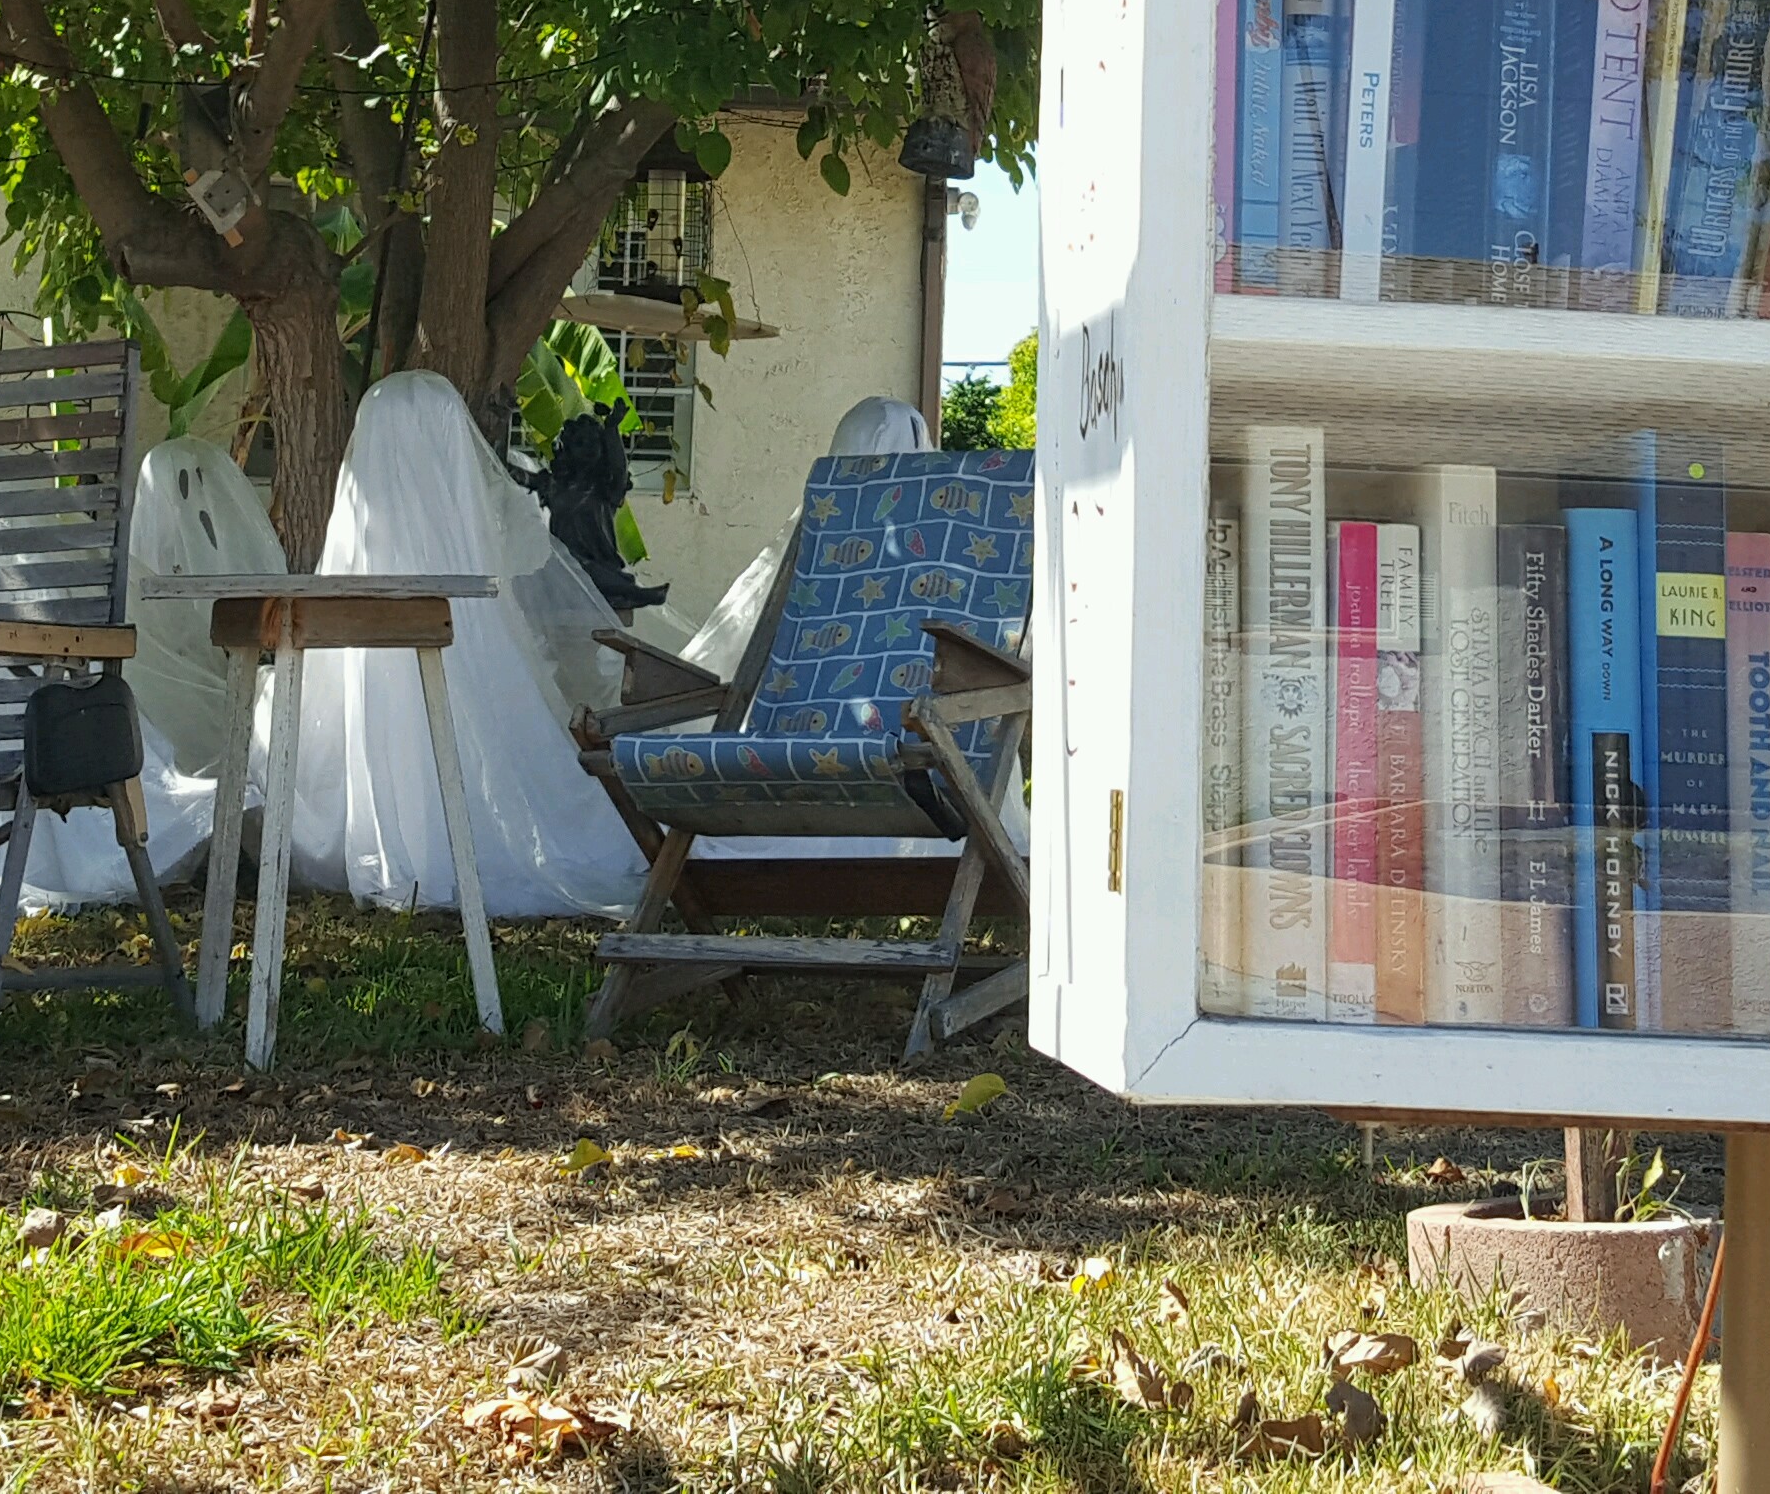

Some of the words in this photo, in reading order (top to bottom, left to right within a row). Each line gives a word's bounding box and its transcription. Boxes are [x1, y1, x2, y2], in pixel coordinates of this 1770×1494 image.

[1499, 43, 1526, 146] JACKSON
[1519, 61, 1538, 108] LISA
[1598, 27, 1642, 140] TENT
[1270, 443, 1312, 516] TONY
[1448, 501, 1490, 525] Fitch
[1521, 552, 1547, 601] Fifty
[1599, 535, 1614, 552] A
[1270, 518, 1312, 670] HILLERMAN
[1380, 559, 1395, 612] TREE
[1398, 546, 1414, 629] FAMILY
[1599, 559, 1614, 613] LONG
[1661, 584, 1708, 599] LAURIE
[1669, 607, 1717, 628] KING
[1527, 605, 1547, 680] Shades
[1600, 618, 1614, 658] WAY
[1602, 662, 1614, 701] DOWN
[1527, 685, 1548, 759] Darker
[1682, 728, 1708, 739] THE
[1269, 724, 1312, 821] SACRED
[1450, 688, 1472, 839] GENERATION
[1603, 751, 1621, 820] NICK
[1389, 755, 1406, 857] BARBARA
[1269, 821, 1312, 931] CLOWNS
[1605, 836, 1622, 959] HORNBY
[1388, 868, 1407, 976] DELINSKY
[1529, 893, 1547, 955] James
